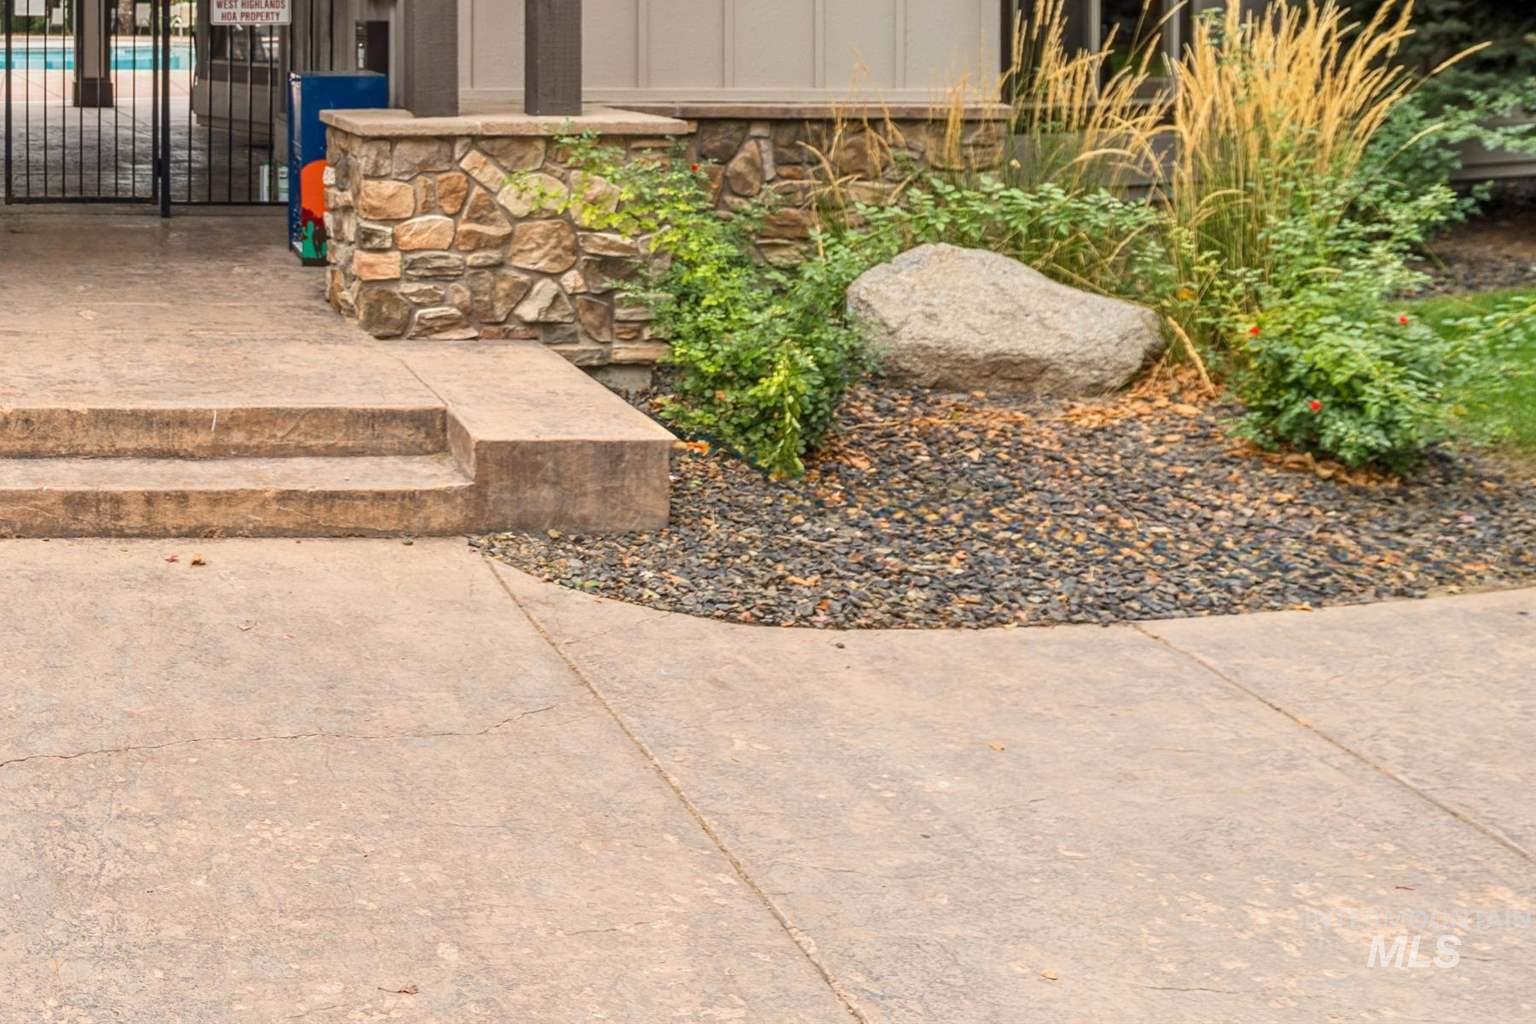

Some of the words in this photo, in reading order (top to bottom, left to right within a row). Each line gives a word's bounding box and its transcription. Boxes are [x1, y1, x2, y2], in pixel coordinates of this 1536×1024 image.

[216, 0, 238, 9] WEST
[241, 0, 286, 9] HIGHLANDS
[221, 11, 237, 21] HOA
[240, 11, 281, 21] PROPERTY
